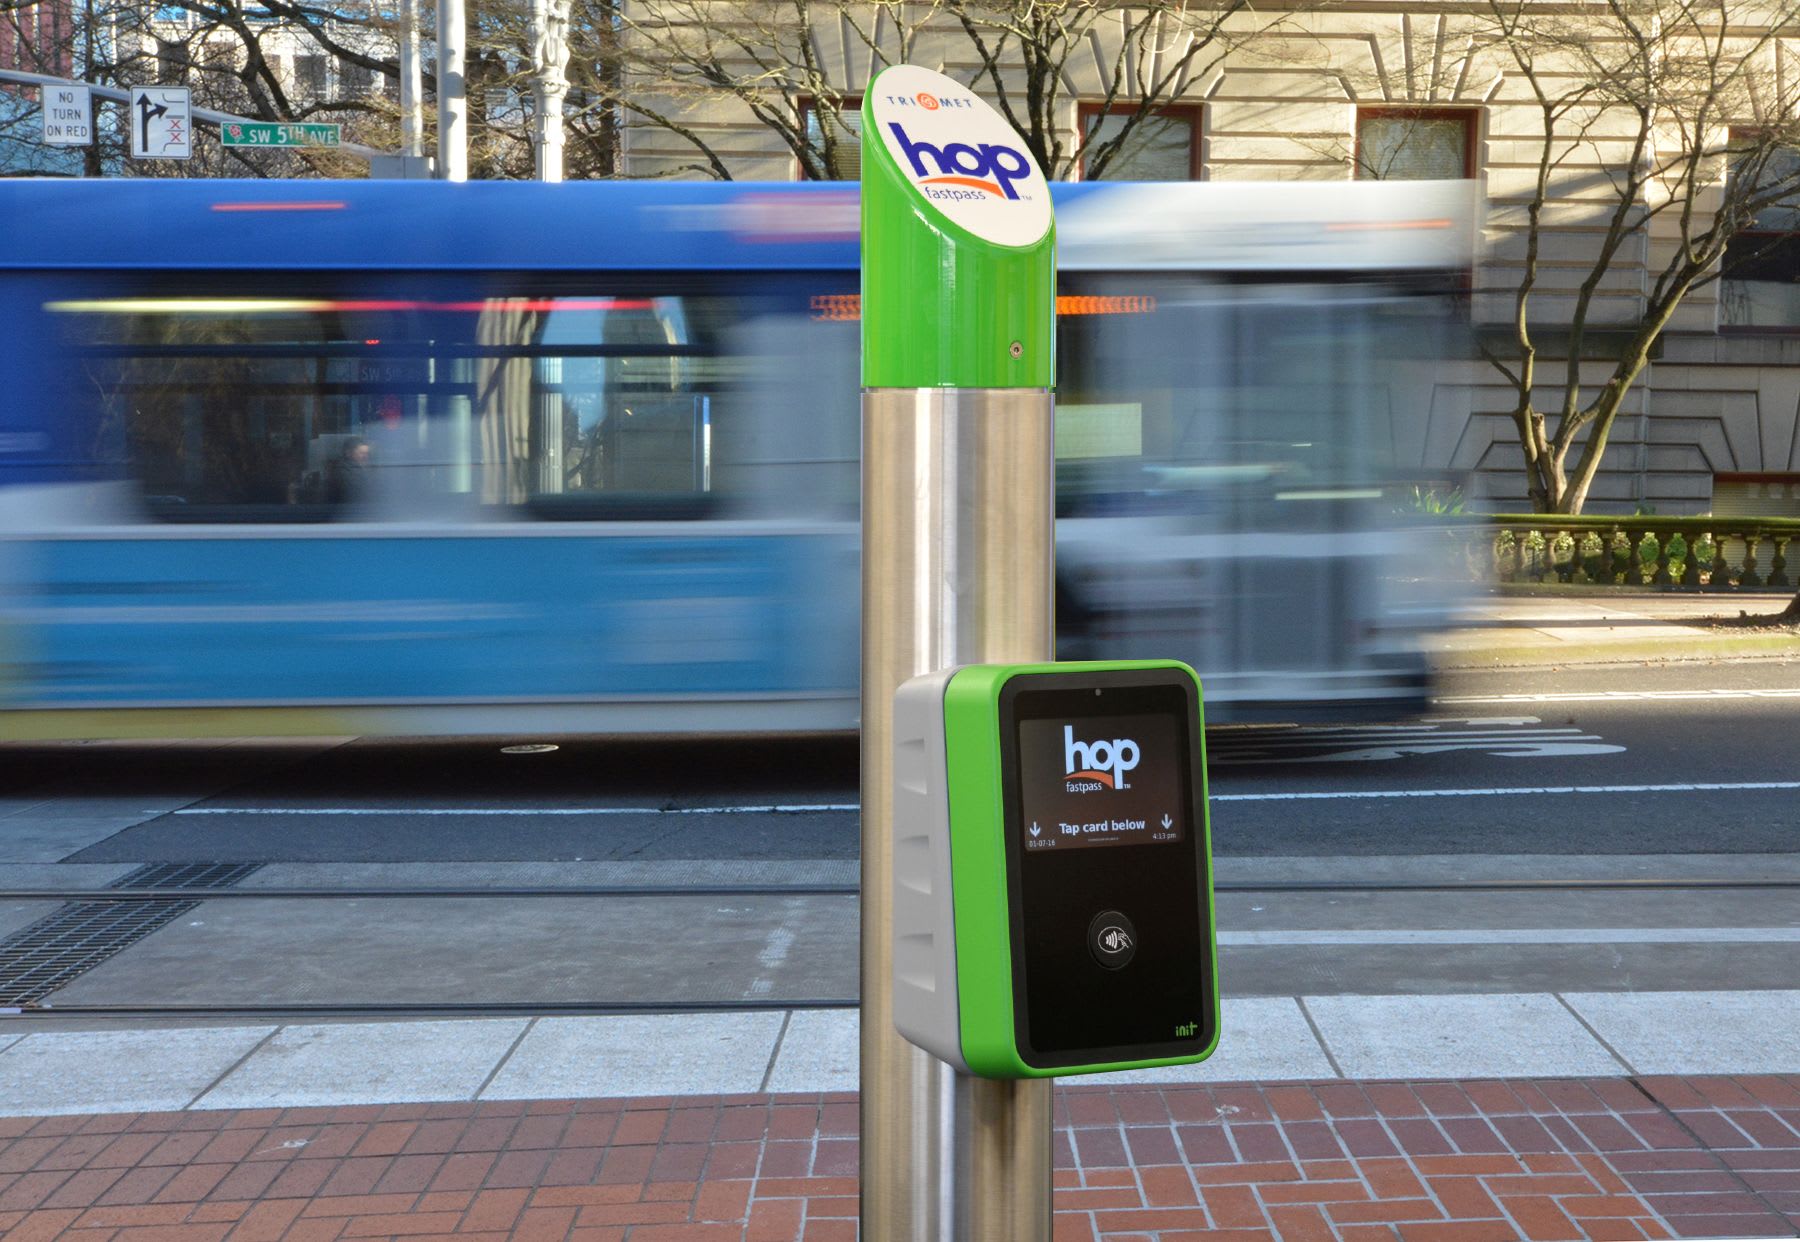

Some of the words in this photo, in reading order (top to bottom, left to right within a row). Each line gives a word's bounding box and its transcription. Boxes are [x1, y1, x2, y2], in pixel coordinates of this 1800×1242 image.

[58, 91, 74, 103] NO
[886, 95, 915, 107] TRI
[939, 97, 973, 108] MET
[52, 108, 82, 120] TURN
[46, 124, 62, 136] ON
[66, 125, 88, 137] RED
[249, 129, 271, 143] SW
[277, 126, 304, 144] 5TH
[310, 130, 335, 145] AVE
[887, 122, 1031, 201] hop
[924, 186, 986, 202] fastpass
[1063, 725, 1140, 790] hop
[1065, 781, 1102, 794] fastpass
[1058, 822, 1080, 836] Tap
[1082, 820, 1108, 833] card
[1111, 818, 1146, 831] below
[1028, 838, 1056, 848] 01-07-16
[1152, 832, 1166, 840] 4:13
[1167, 832, 1177, 841] pm
[1175, 1021, 1198, 1037] init
